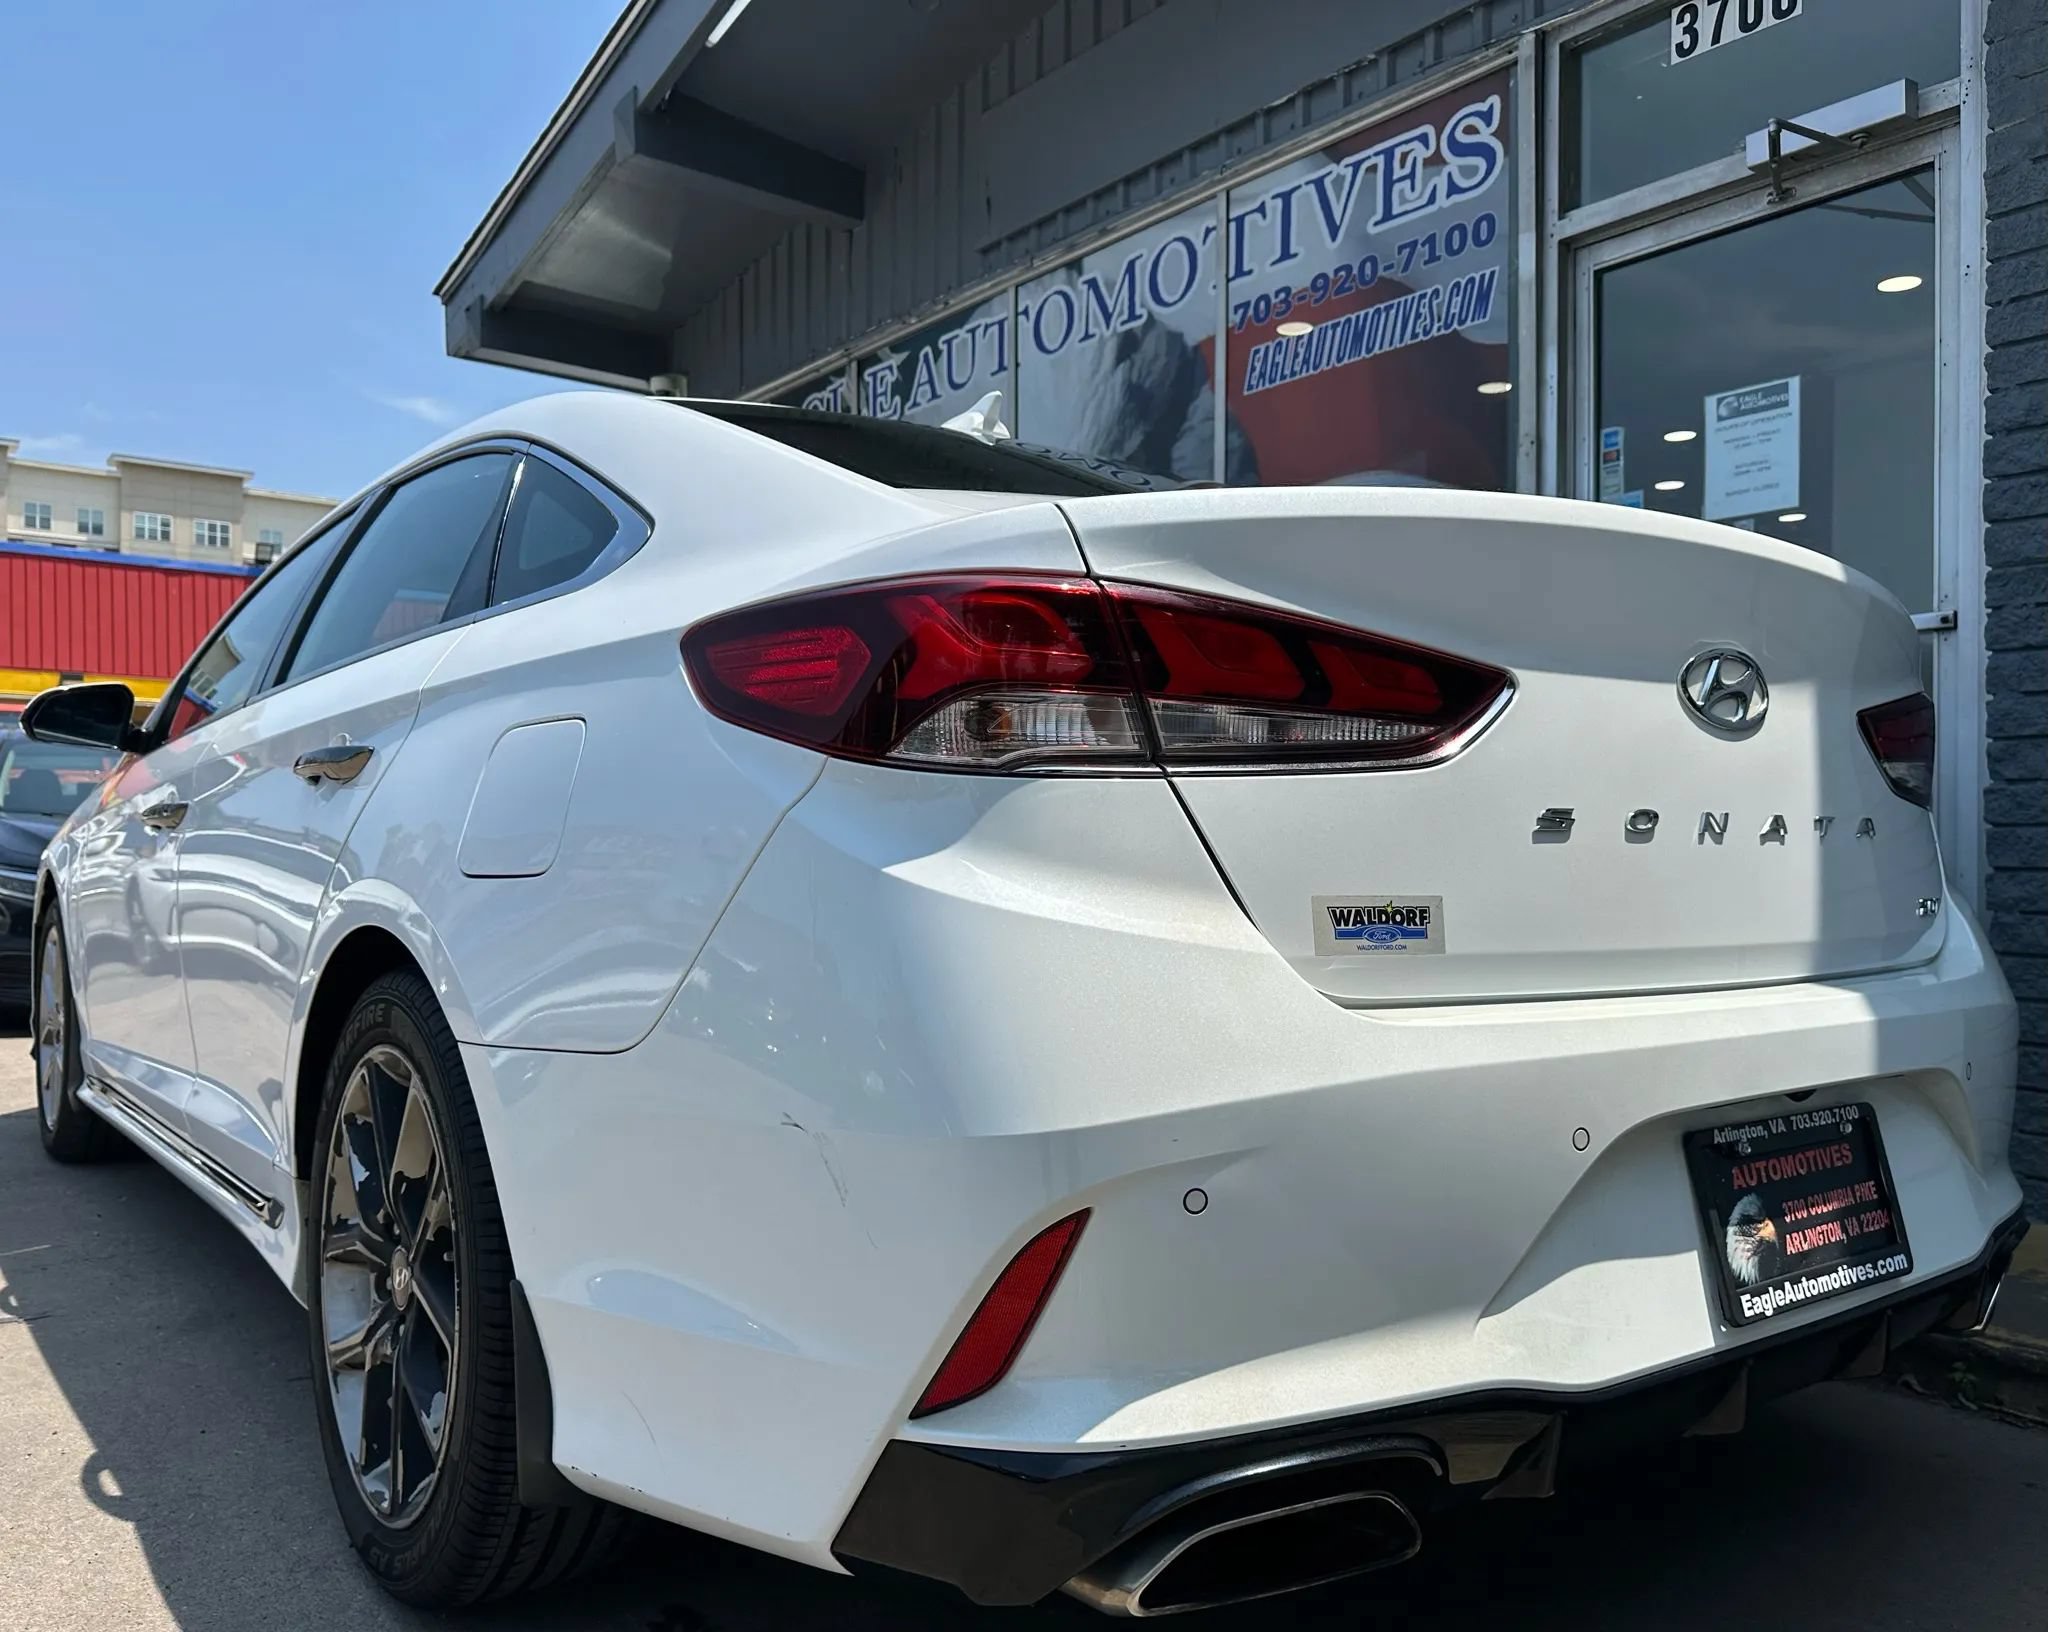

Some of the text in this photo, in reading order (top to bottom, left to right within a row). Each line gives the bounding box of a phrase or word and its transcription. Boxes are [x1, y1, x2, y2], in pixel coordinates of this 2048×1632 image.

[904, 96, 1503, 413] AUTOMOTIVES
[1233, 211, 1497, 333] 703-920-7100
[1244, 267, 1498, 395] EAGLEAUTOMOTIVES.COM
[1533, 808, 1876, 842] SONATA
[1329, 907, 1429, 927] WALDORF
[1373, 930, 1392, 941] Ford
[1713, 1105, 1859, 1144] Arlington, VA 703.920.7100
[1731, 1143, 1853, 1190] AUTOMOTIVES
[1782, 1180, 1879, 1223] 3700 COLUMBIA PIKE
[1784, 1209, 1890, 1256] ARLINGTON, VA 22204
[1740, 1253, 1908, 1318] EagleAutomotives.com
